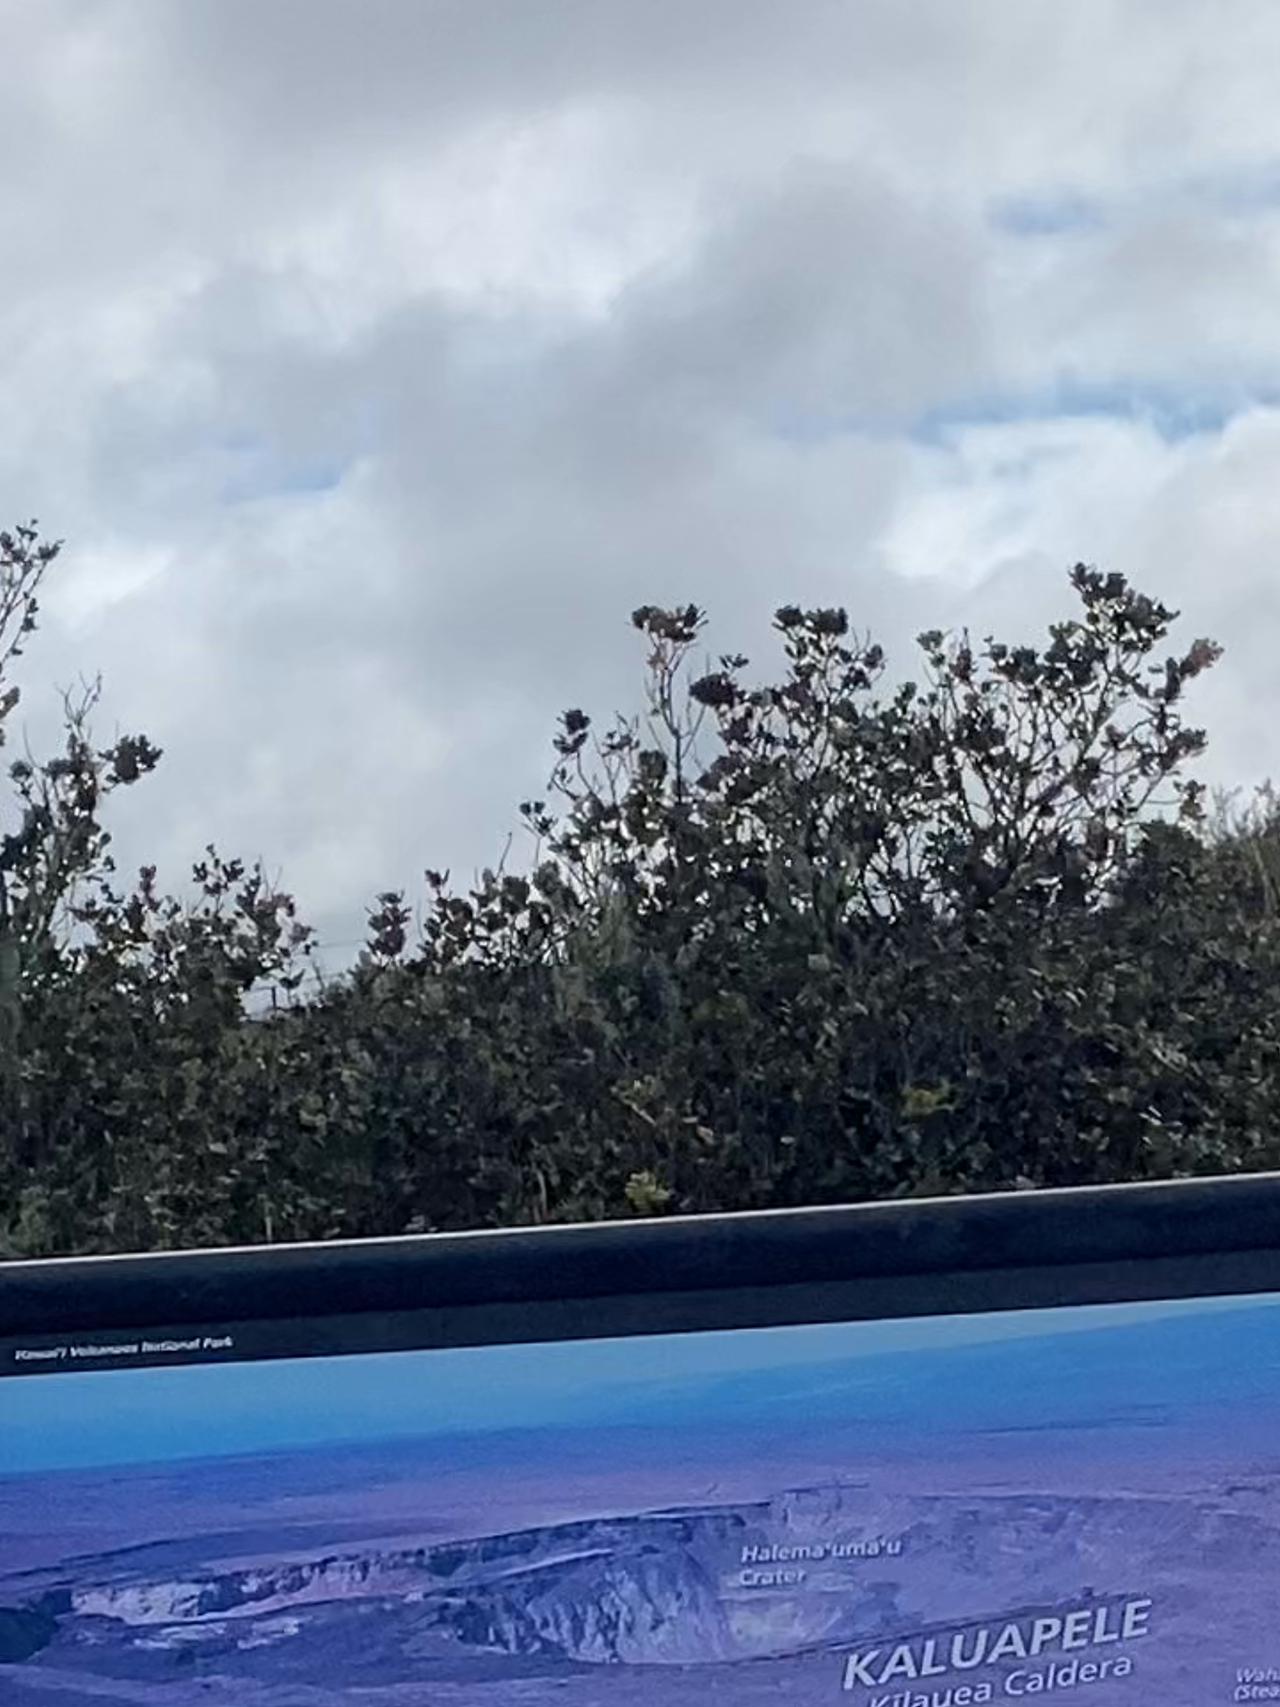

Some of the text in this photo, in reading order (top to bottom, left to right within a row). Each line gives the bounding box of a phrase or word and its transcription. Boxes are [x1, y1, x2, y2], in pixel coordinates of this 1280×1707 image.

[738, 1569, 807, 1588] Crater
[842, 1598, 1152, 1691] KALUAPELE
[1004, 1653, 1132, 1697] Caldera
